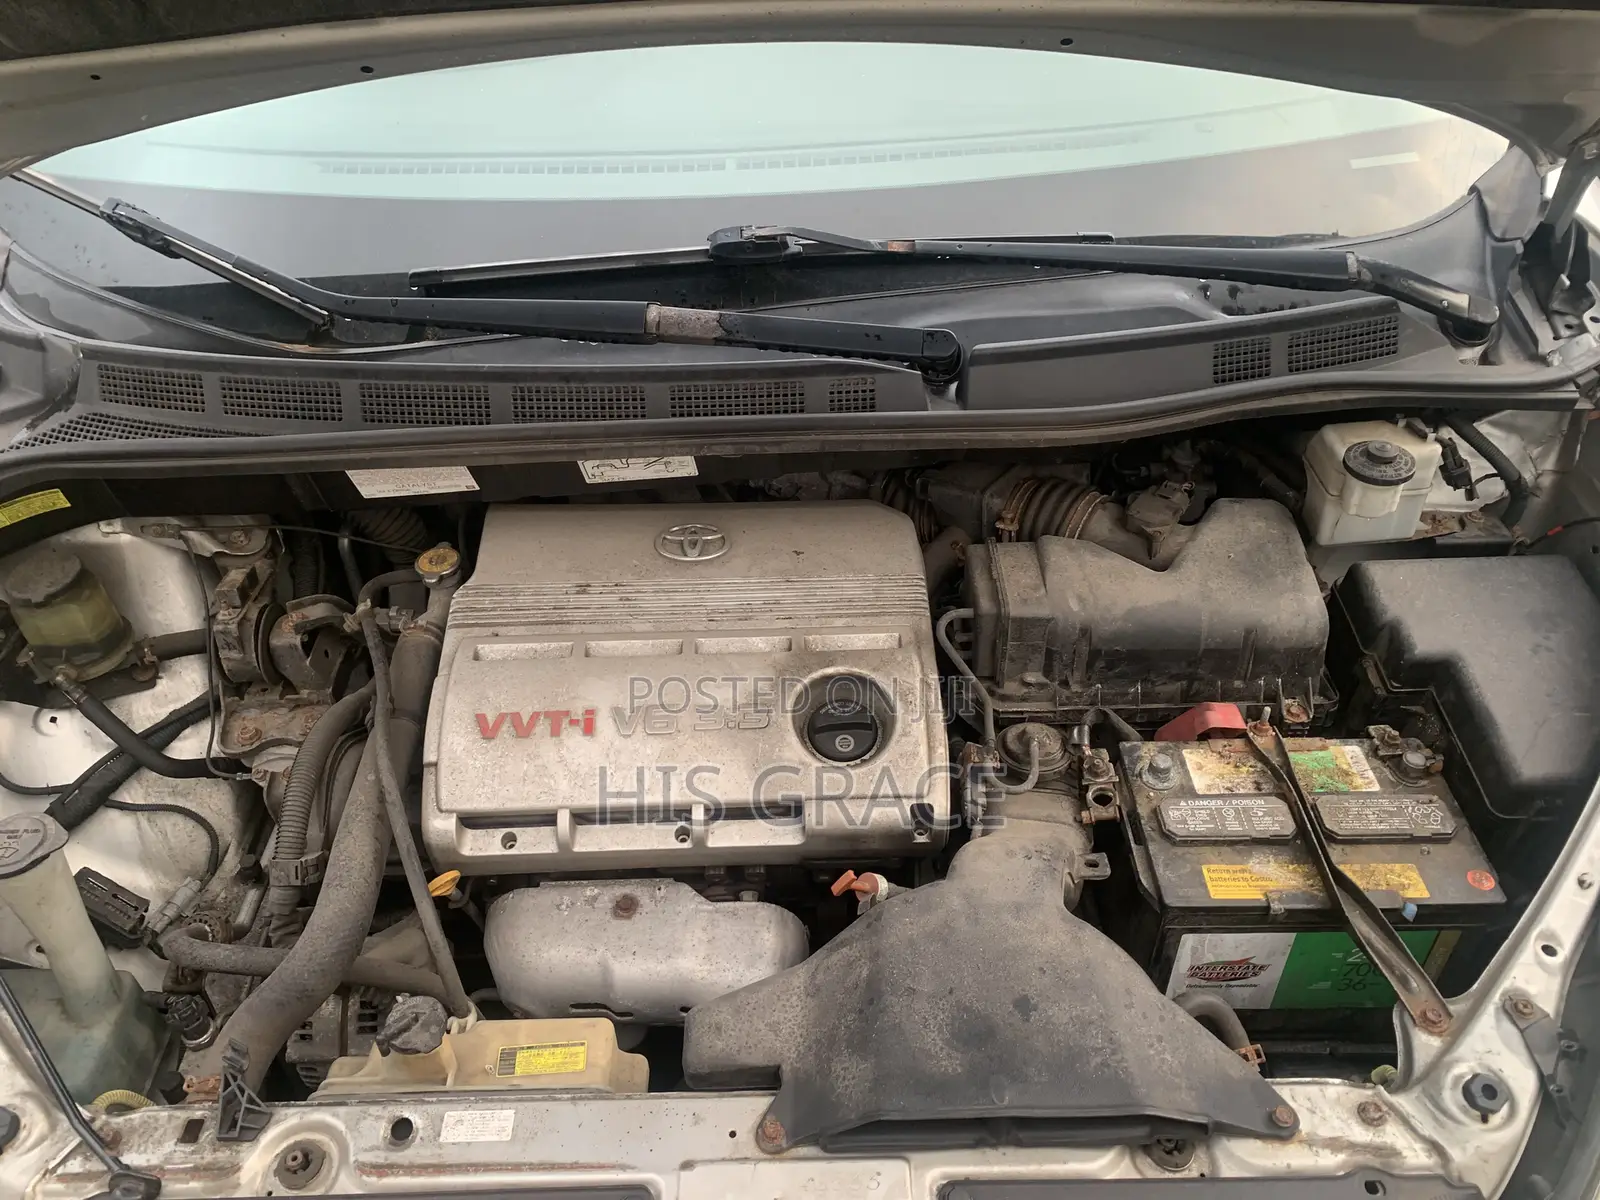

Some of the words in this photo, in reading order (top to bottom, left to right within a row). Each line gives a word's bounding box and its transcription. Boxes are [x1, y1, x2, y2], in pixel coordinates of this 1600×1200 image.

[475, 708, 597, 739] VVT-i
[611, 704, 678, 737] V6
[694, 703, 771, 732] 3.5
[1187, 964, 1269, 972] INTERSTATE
